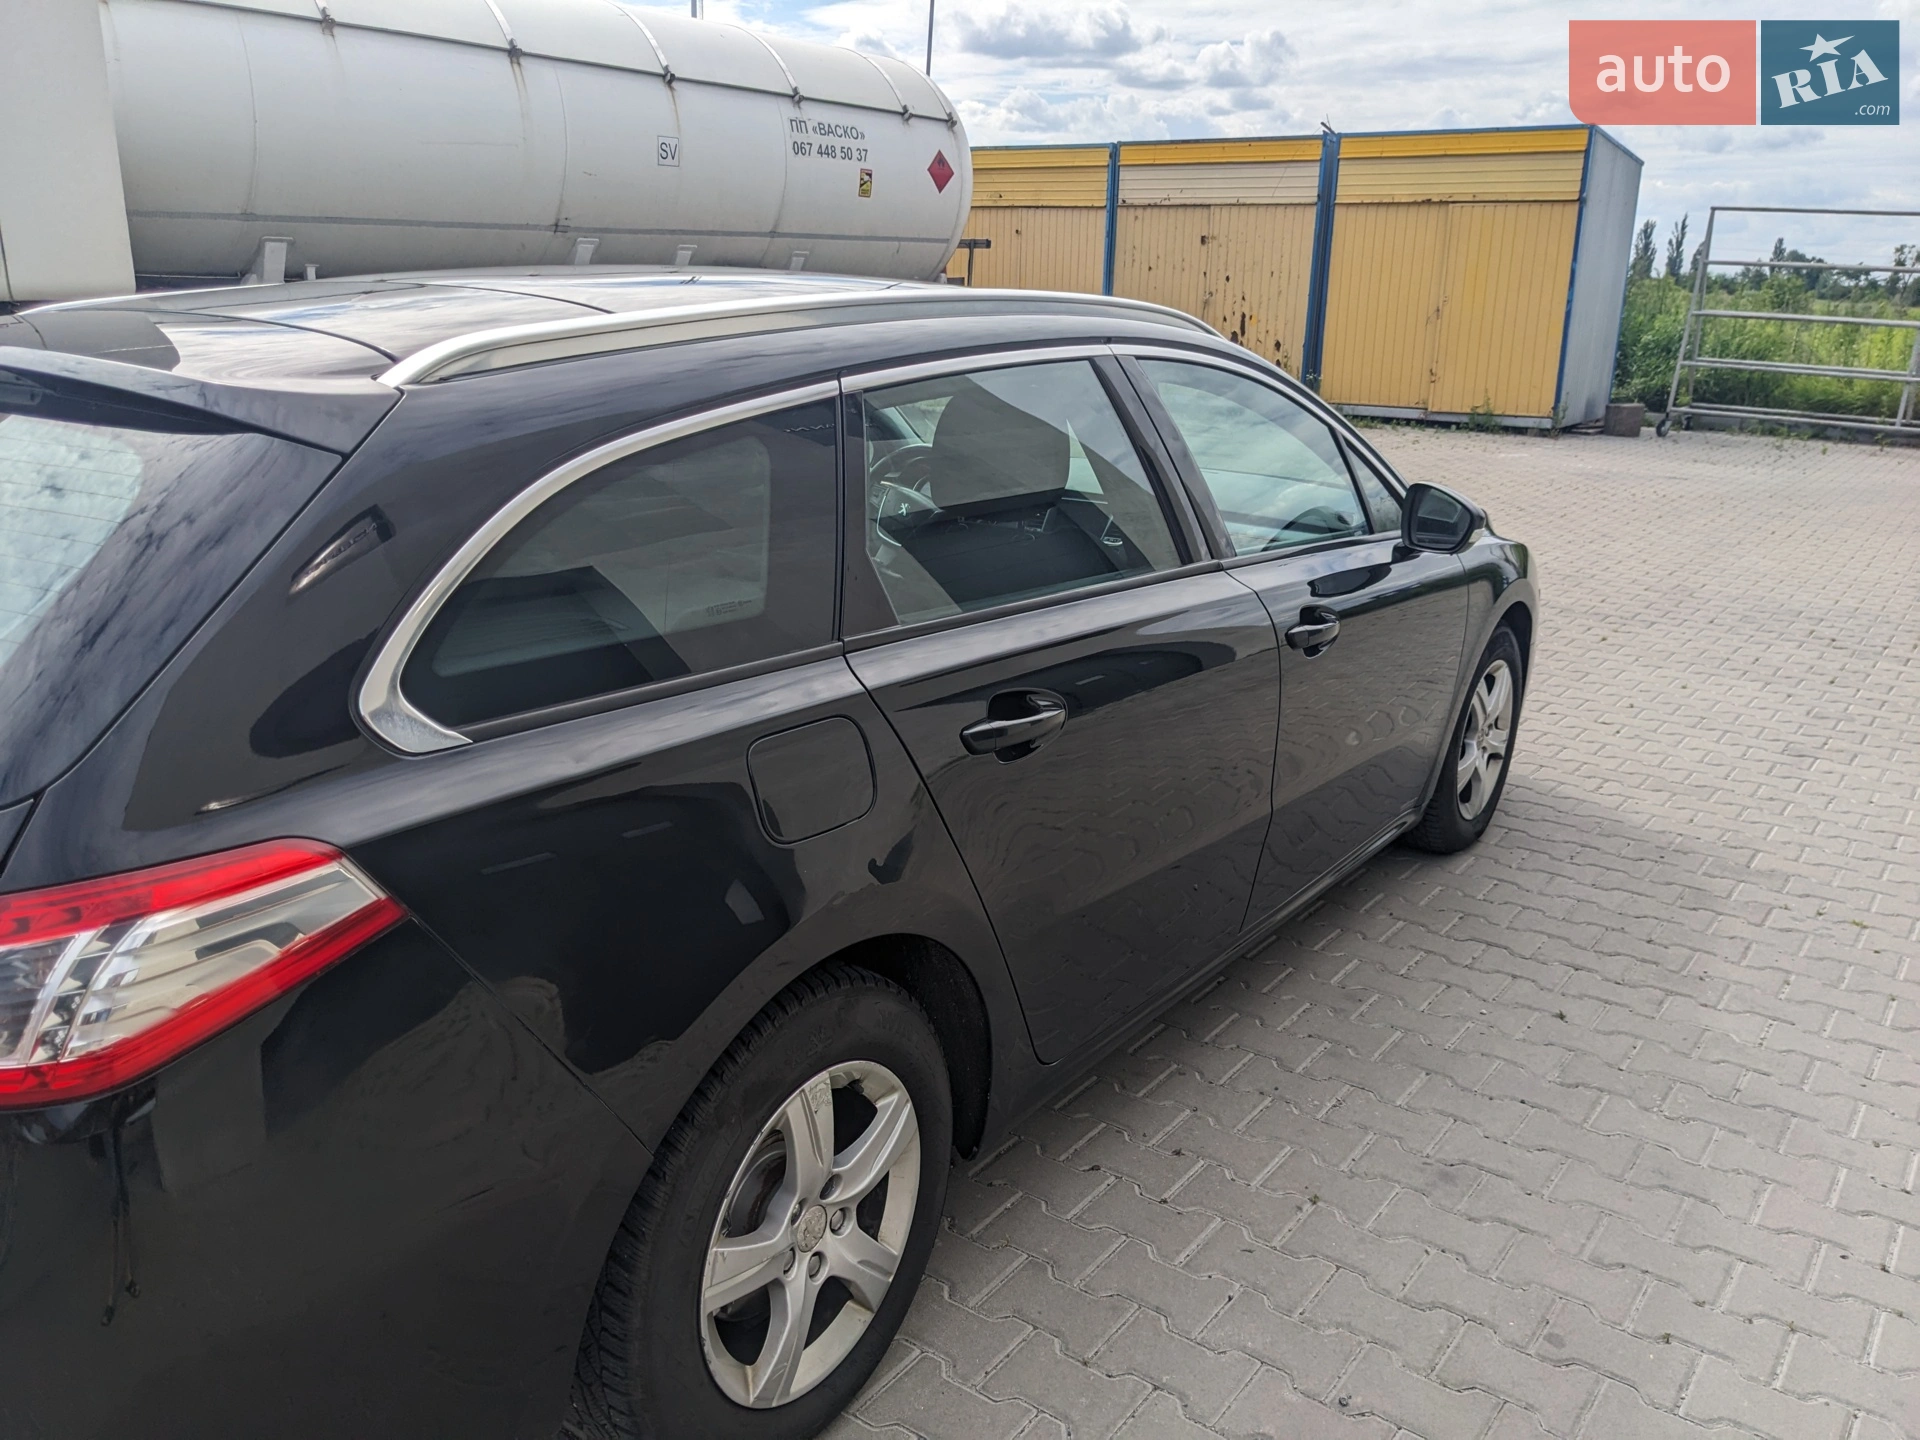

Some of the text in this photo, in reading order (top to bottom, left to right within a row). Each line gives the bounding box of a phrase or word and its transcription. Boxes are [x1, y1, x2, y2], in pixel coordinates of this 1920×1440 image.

[790, 119, 866, 140] ПП «ВАСКО»
[659, 142, 678, 161] SV
[792, 141, 868, 162] 067 448 50 37
